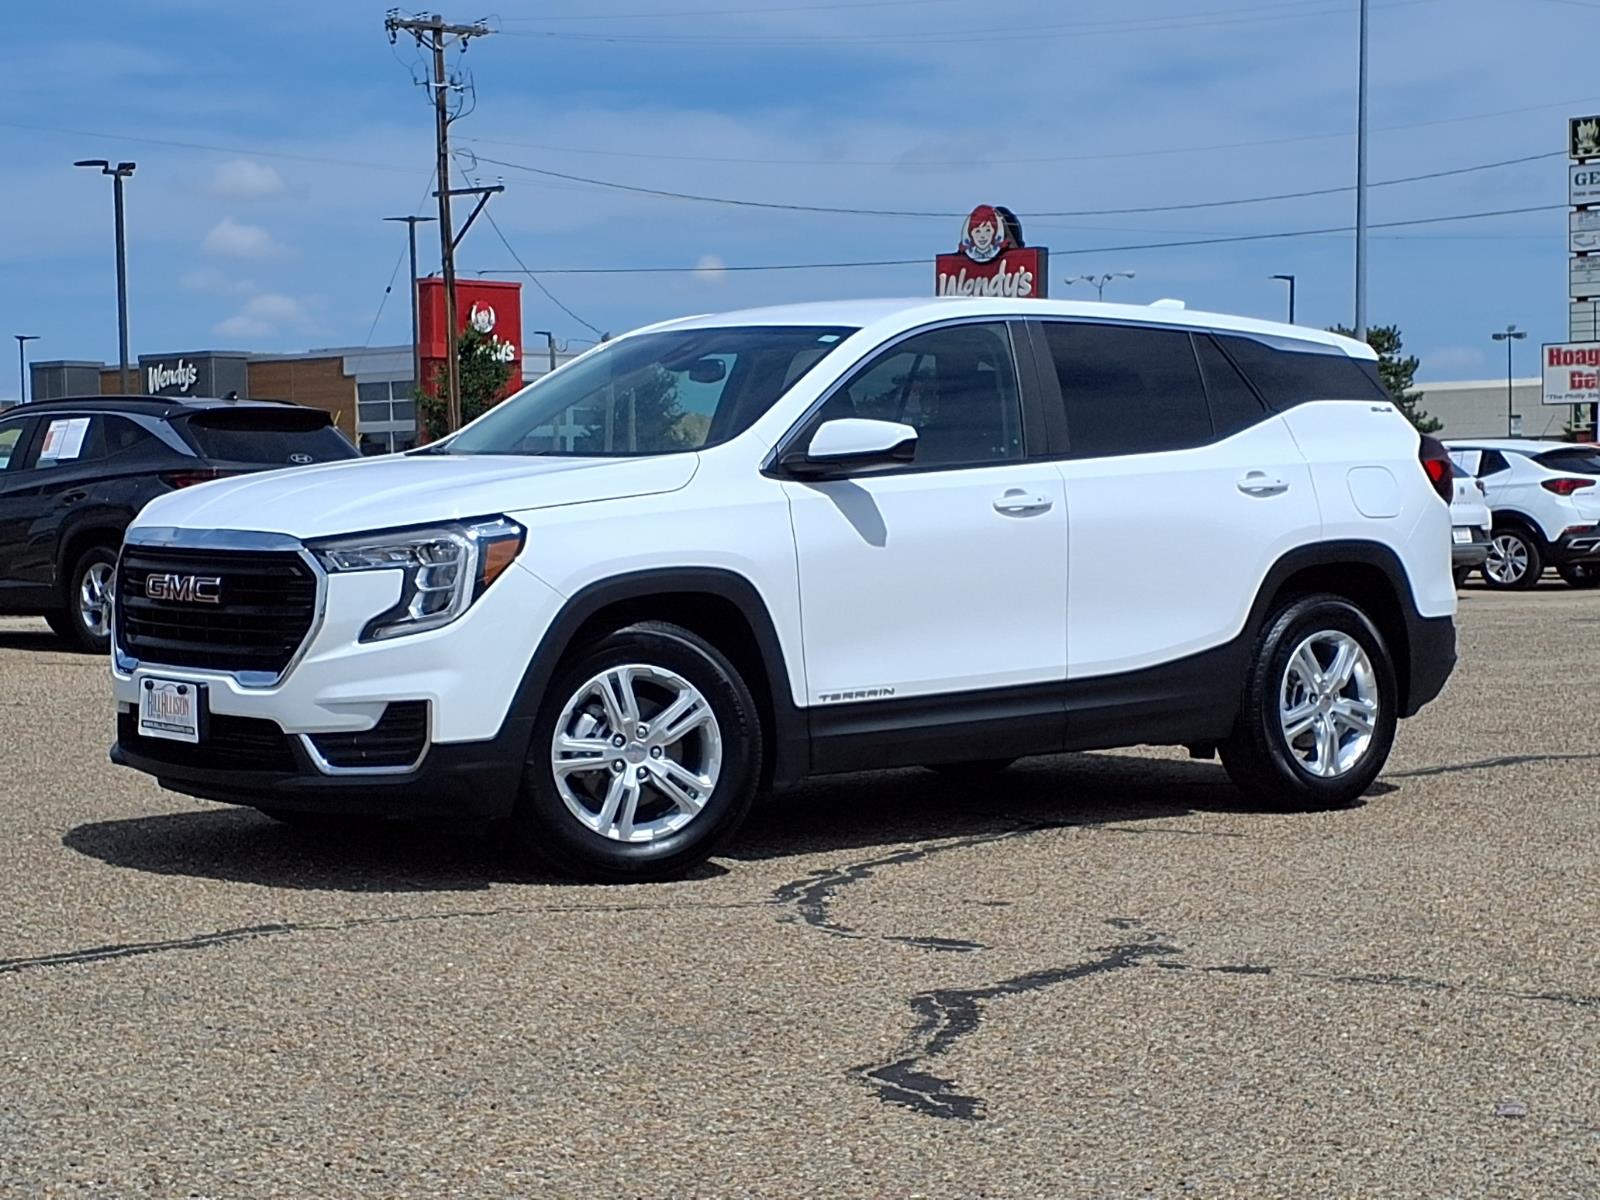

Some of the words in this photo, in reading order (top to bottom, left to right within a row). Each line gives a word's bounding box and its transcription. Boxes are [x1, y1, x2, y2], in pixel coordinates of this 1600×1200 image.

[939, 259, 1033, 297] Wendy's
[148, 359, 197, 394] Wendy's
[145, 573, 221, 603] GMC
[818, 687, 895, 702] TERRAIN
